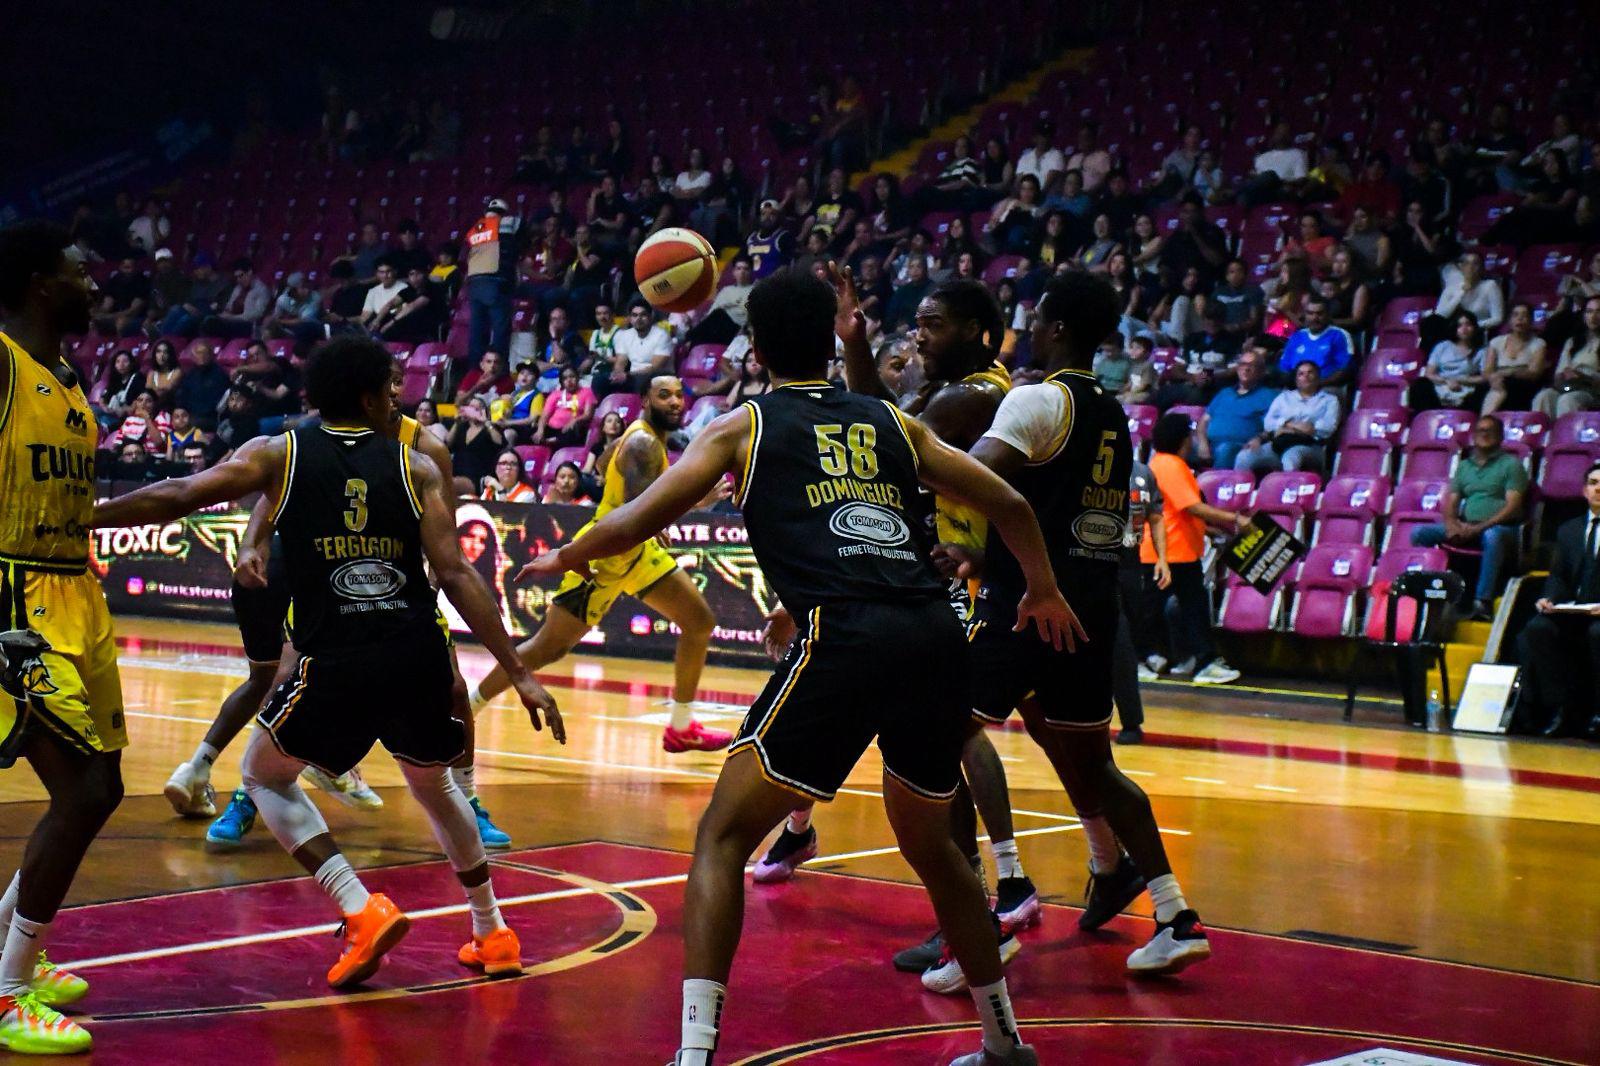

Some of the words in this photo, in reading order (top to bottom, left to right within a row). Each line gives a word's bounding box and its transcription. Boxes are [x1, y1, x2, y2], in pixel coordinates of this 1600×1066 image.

[814, 422, 880, 479] 58
[1091, 429, 1118, 485] 5
[343, 478, 369, 532] 3
[805, 478, 905, 510] DOMINGUEZ
[312, 535, 405, 561] FERGUSON
[347, 573, 389, 585] TOMASON
